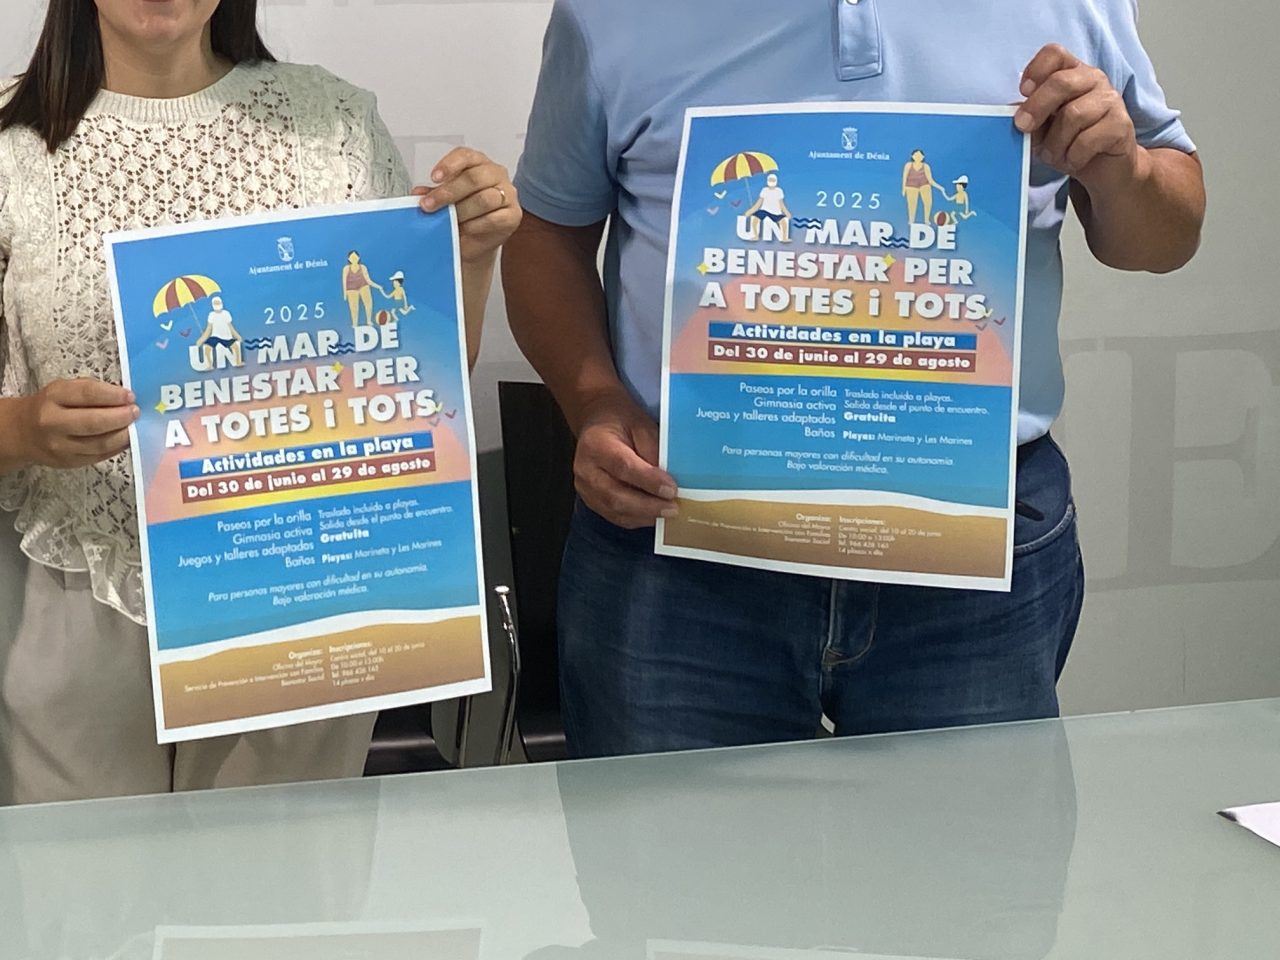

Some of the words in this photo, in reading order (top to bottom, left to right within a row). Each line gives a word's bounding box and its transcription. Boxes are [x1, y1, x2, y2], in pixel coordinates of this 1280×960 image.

[808, 150, 853, 159] Ajuntament
[853, 151, 865, 159] de
[865, 151, 890, 161] Dénia
[815, 189, 880, 209] 2025
[735, 214, 791, 242] UN
[803, 218, 893, 246] MAR
[908, 221, 956, 250] DE
[248, 262, 292, 275] Ajuntament
[294, 260, 304, 269] de
[305, 258, 328, 268] Dénia
[703, 247, 887, 281] BENESTAR
[903, 256, 972, 284] PER
[698, 280, 726, 307] A
[739, 282, 852, 314] TOTES
[868, 287, 880, 316] i
[894, 290, 986, 319] TOTS
[263, 301, 325, 325] 2025
[188, 339, 244, 371] UN
[256, 329, 339, 364] MAR
[352, 321, 399, 352] DE
[731, 322, 841, 342] Actividades
[847, 332, 871, 343] en
[877, 329, 896, 345] la
[902, 331, 956, 351] playa
[713, 343, 740, 357] Del
[745, 346, 768, 359] 30
[772, 347, 793, 360] de
[798, 348, 839, 363] junio
[842, 350, 859, 364] al
[864, 351, 888, 365] 29
[891, 352, 912, 366] de
[917, 356, 970, 370] agosto
[160, 365, 338, 410] BENESTAR
[351, 356, 419, 388] PER
[738, 381, 775, 394] Paseos
[775, 386, 795, 397] por
[796, 384, 808, 396] la
[809, 384, 837, 397] orilla
[752, 395, 803, 409] Gimnasia
[805, 400, 837, 411] activa
[164, 418, 191, 448] A
[201, 403, 310, 442] TOTES
[322, 398, 335, 428] i
[347, 388, 436, 424] TOTS
[695, 407, 731, 422] Juegos
[732, 411, 740, 422] y
[741, 408, 779, 422] talleres
[780, 411, 836, 425] adaptados
[842, 410, 896, 423] Gratuita
[803, 425, 835, 438] Baños
[201, 449, 305, 473] Actividades
[310, 446, 334, 460] en
[337, 440, 358, 456] la
[362, 437, 415, 457] playa
[186, 482, 213, 498] Del
[217, 479, 239, 494] 30
[243, 476, 263, 491] de
[266, 471, 306, 491] junio
[310, 467, 326, 482] al
[330, 465, 353, 480] 29
[356, 462, 376, 476] de
[380, 457, 431, 475] agosto
[216, 520, 252, 532] Paseos
[253, 517, 272, 531] por
[272, 512, 284, 525] la
[285, 508, 312, 524] orilla
[231, 531, 281, 545] Gimnasia
[282, 526, 313, 539] activa
[319, 528, 369, 543] Gratuita
[177, 554, 213, 568] Juegos
[213, 553, 222, 565] y
[222, 546, 259, 561] talleres
[260, 539, 314, 556] adaptados
[284, 554, 315, 568] Baños
